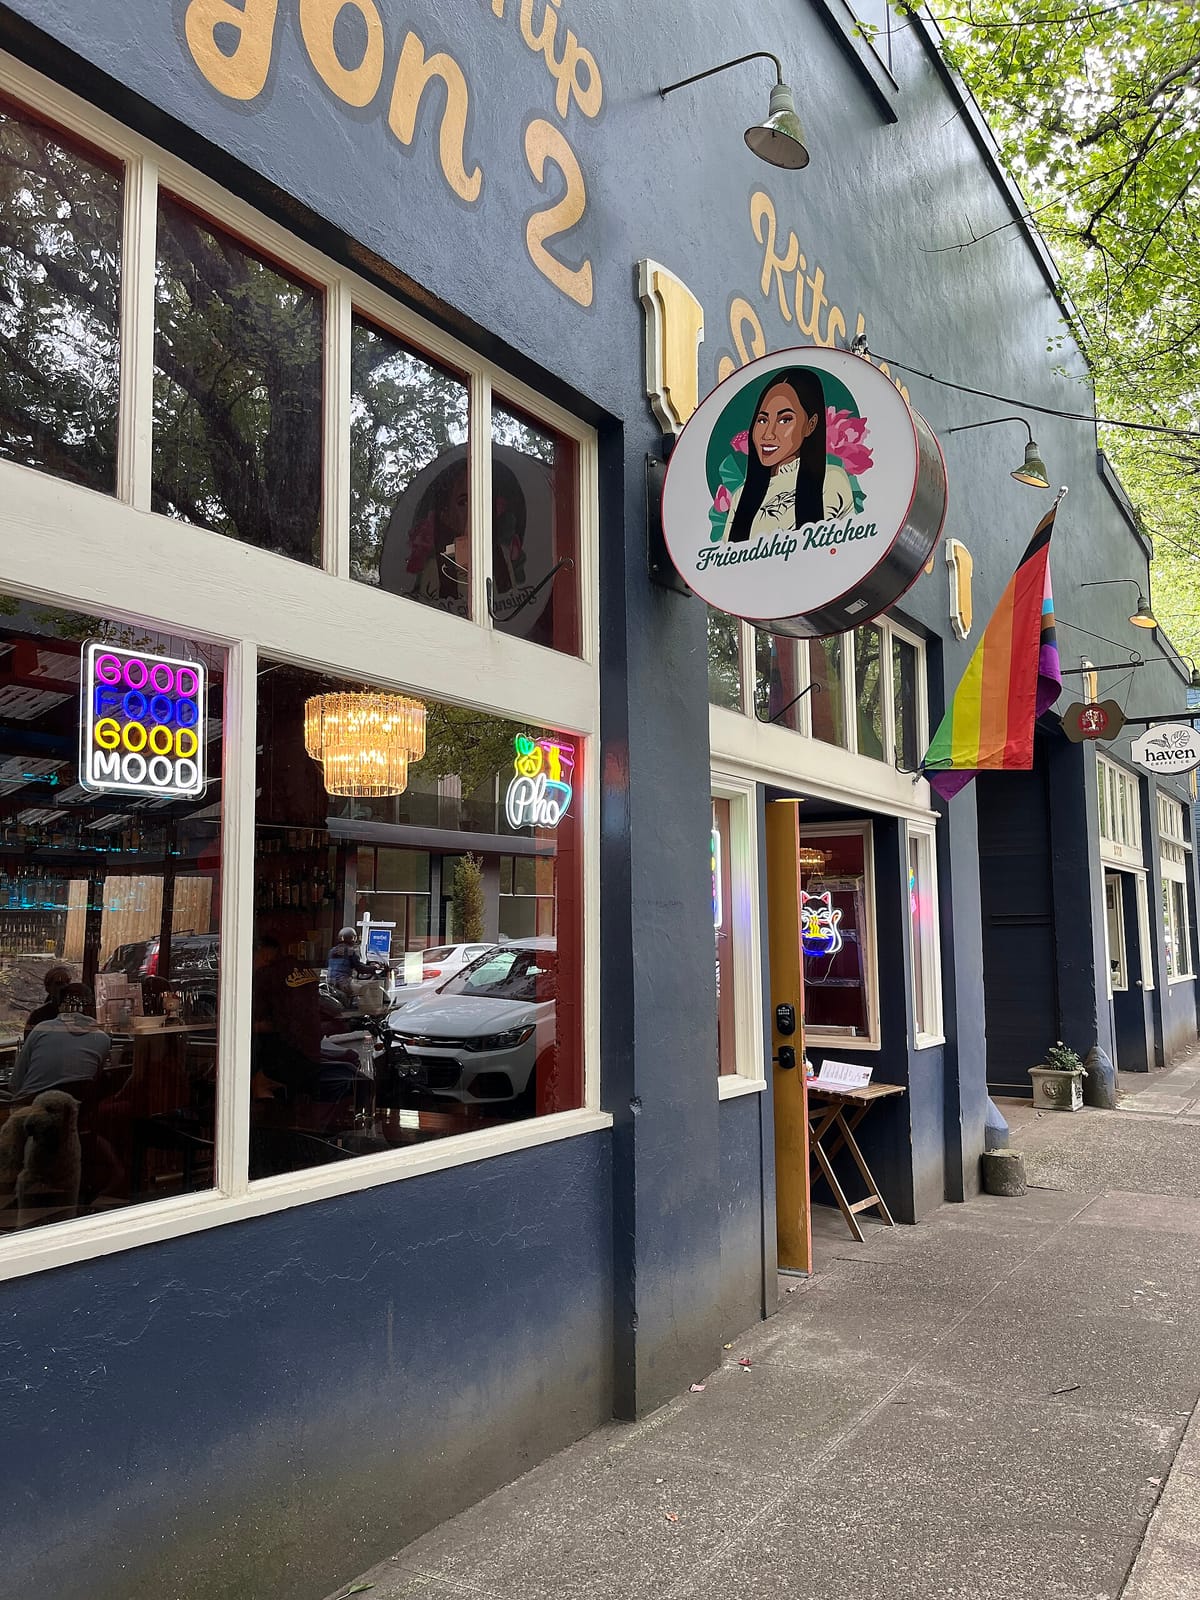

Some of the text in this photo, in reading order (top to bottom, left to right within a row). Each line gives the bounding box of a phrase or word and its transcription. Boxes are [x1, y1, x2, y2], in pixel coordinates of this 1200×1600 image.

[489, 0, 602, 119] ip
[696, 519, 878, 571] Friendship Kitchen
[96, 654, 198, 697] GOOD
[95, 684, 199, 727] FOOD
[94, 717, 198, 758] GOOD
[1144, 748, 1196, 762] haven
[93, 750, 198, 788] MOOD
[509, 773, 561, 825] Pho
